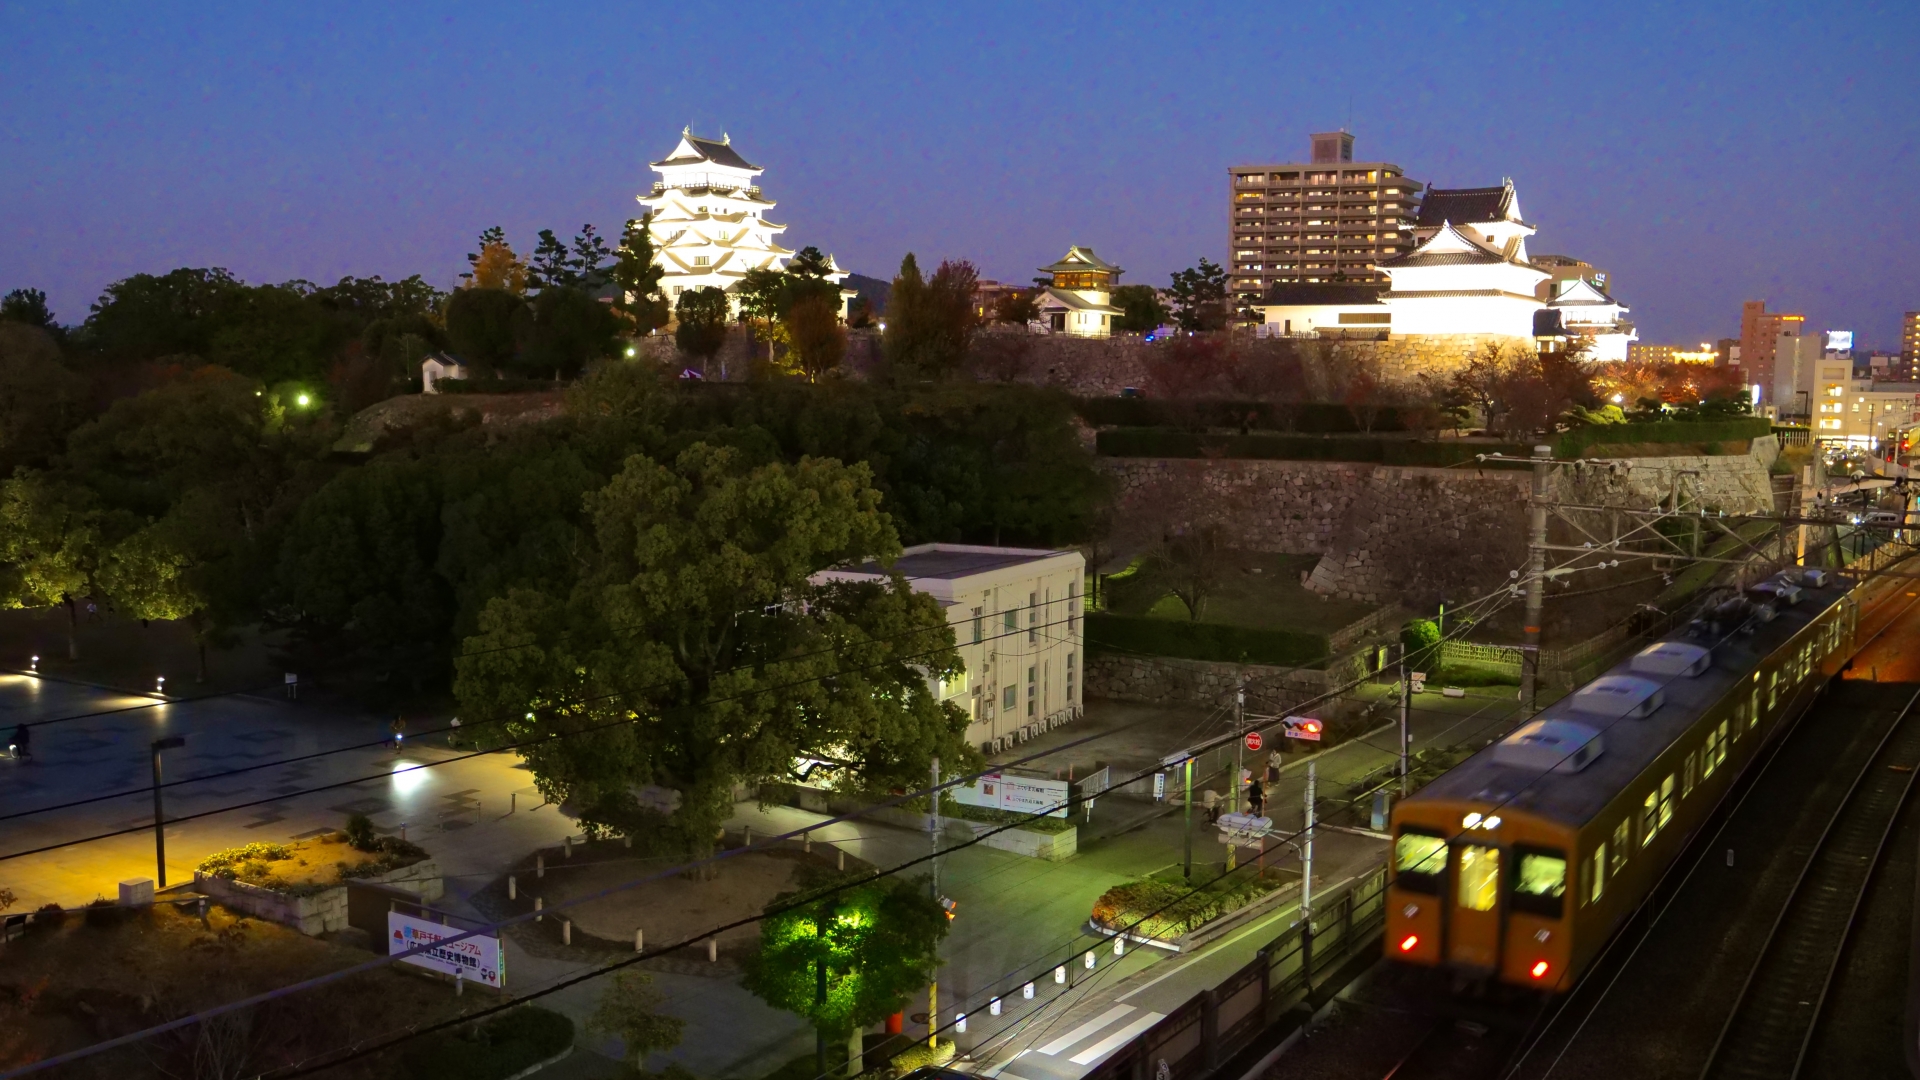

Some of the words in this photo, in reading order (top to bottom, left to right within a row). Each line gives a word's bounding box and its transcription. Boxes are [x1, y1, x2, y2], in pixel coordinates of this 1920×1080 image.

[411, 928, 482, 956] 草戸千軒ュージアム
[1162, 1063, 1168, 1071] 3
